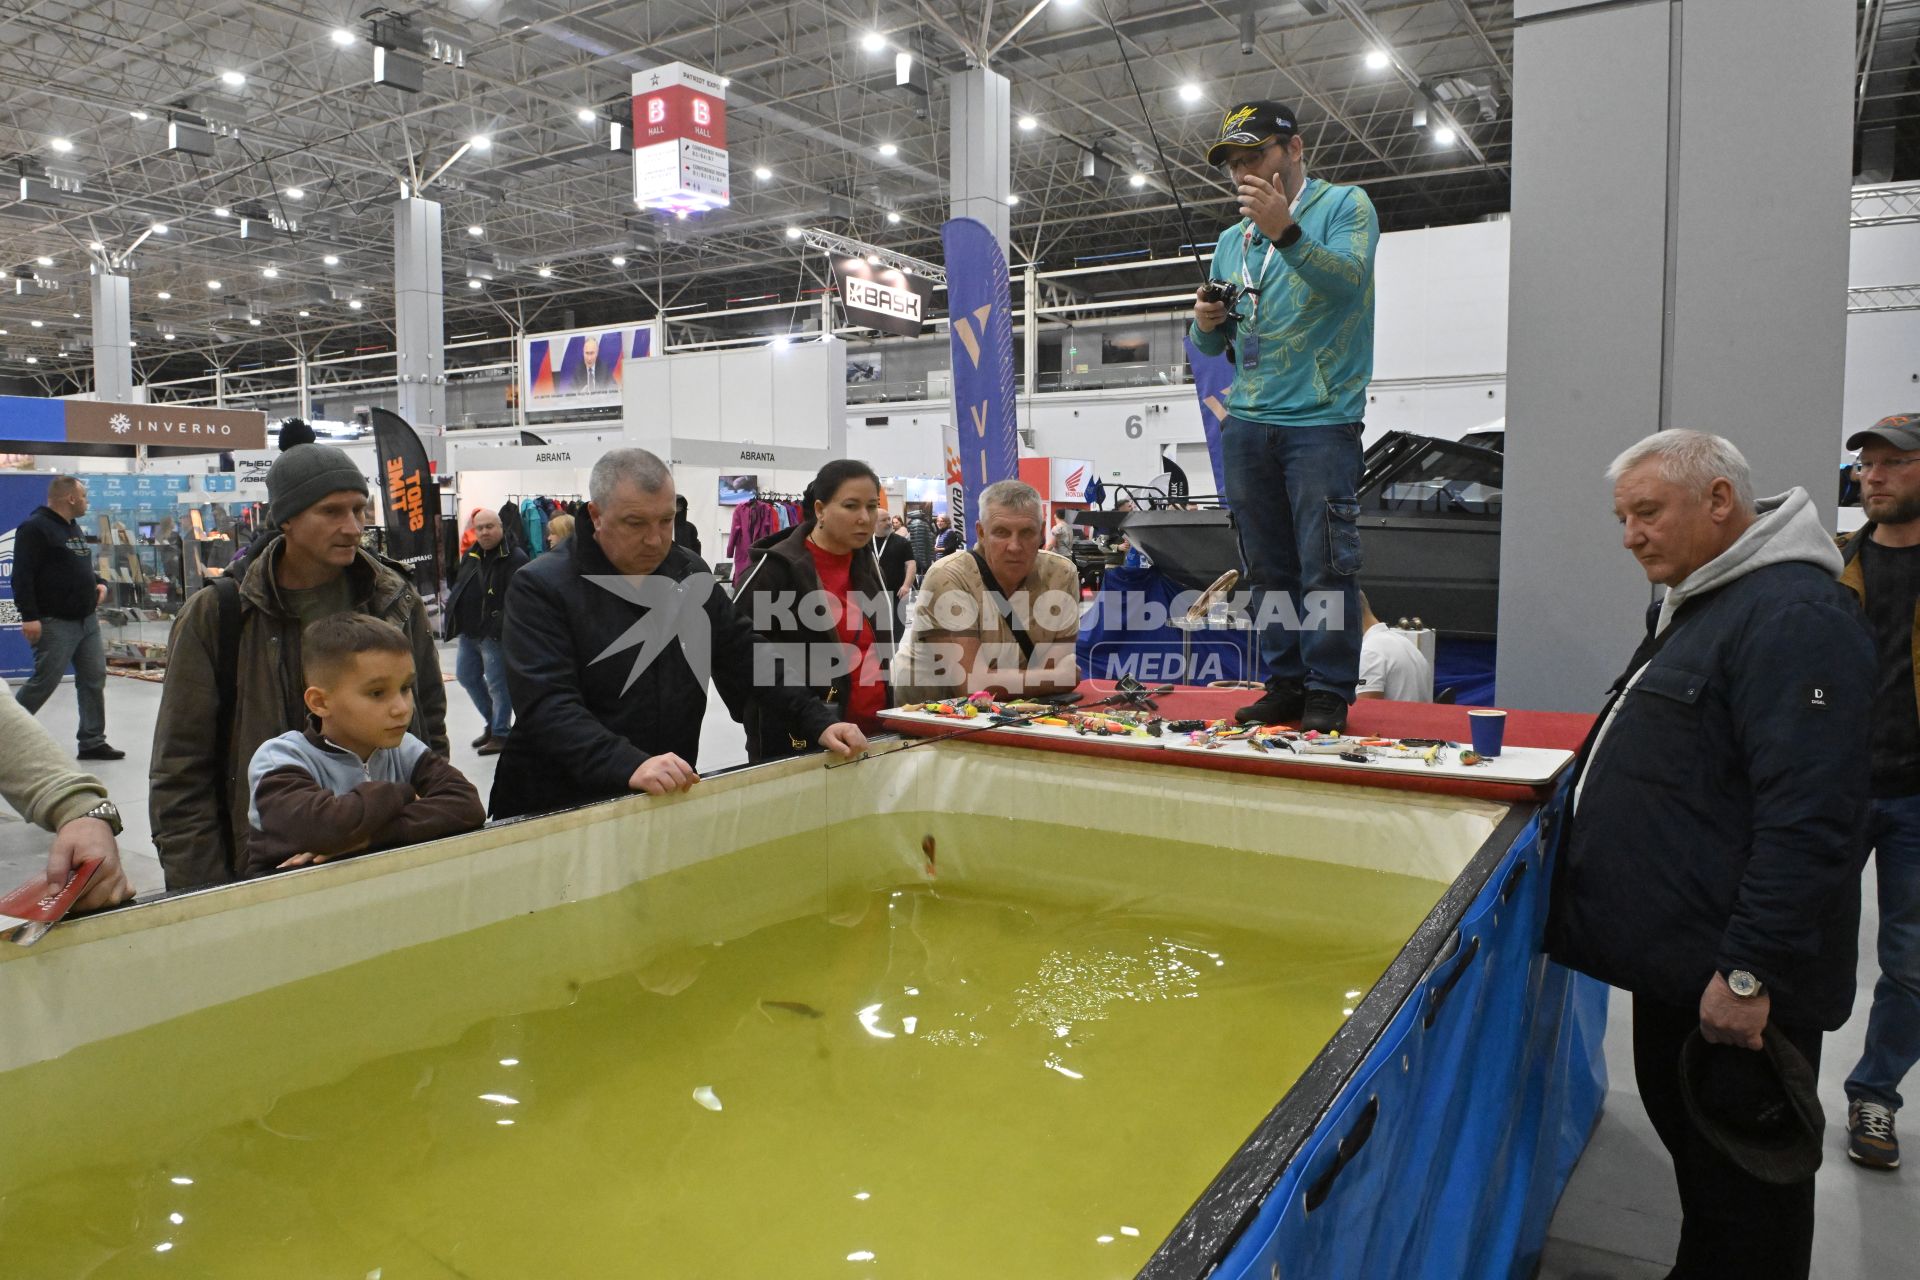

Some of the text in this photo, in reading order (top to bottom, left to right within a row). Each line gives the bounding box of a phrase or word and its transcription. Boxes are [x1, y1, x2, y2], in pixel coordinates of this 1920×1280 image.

[648, 97, 665, 124] B
[693, 98, 711, 125] B
[648, 126, 664, 136] HALL
[694, 126, 711, 138] HALL
[865, 287, 918, 316] BASK
[138, 420, 231, 436] INVERNO
[1125, 415, 1143, 439] 6
[536, 452, 571, 462] ABRANTA
[740, 451, 776, 462] ABRANTA
[1815, 688, 1823, 698] D
